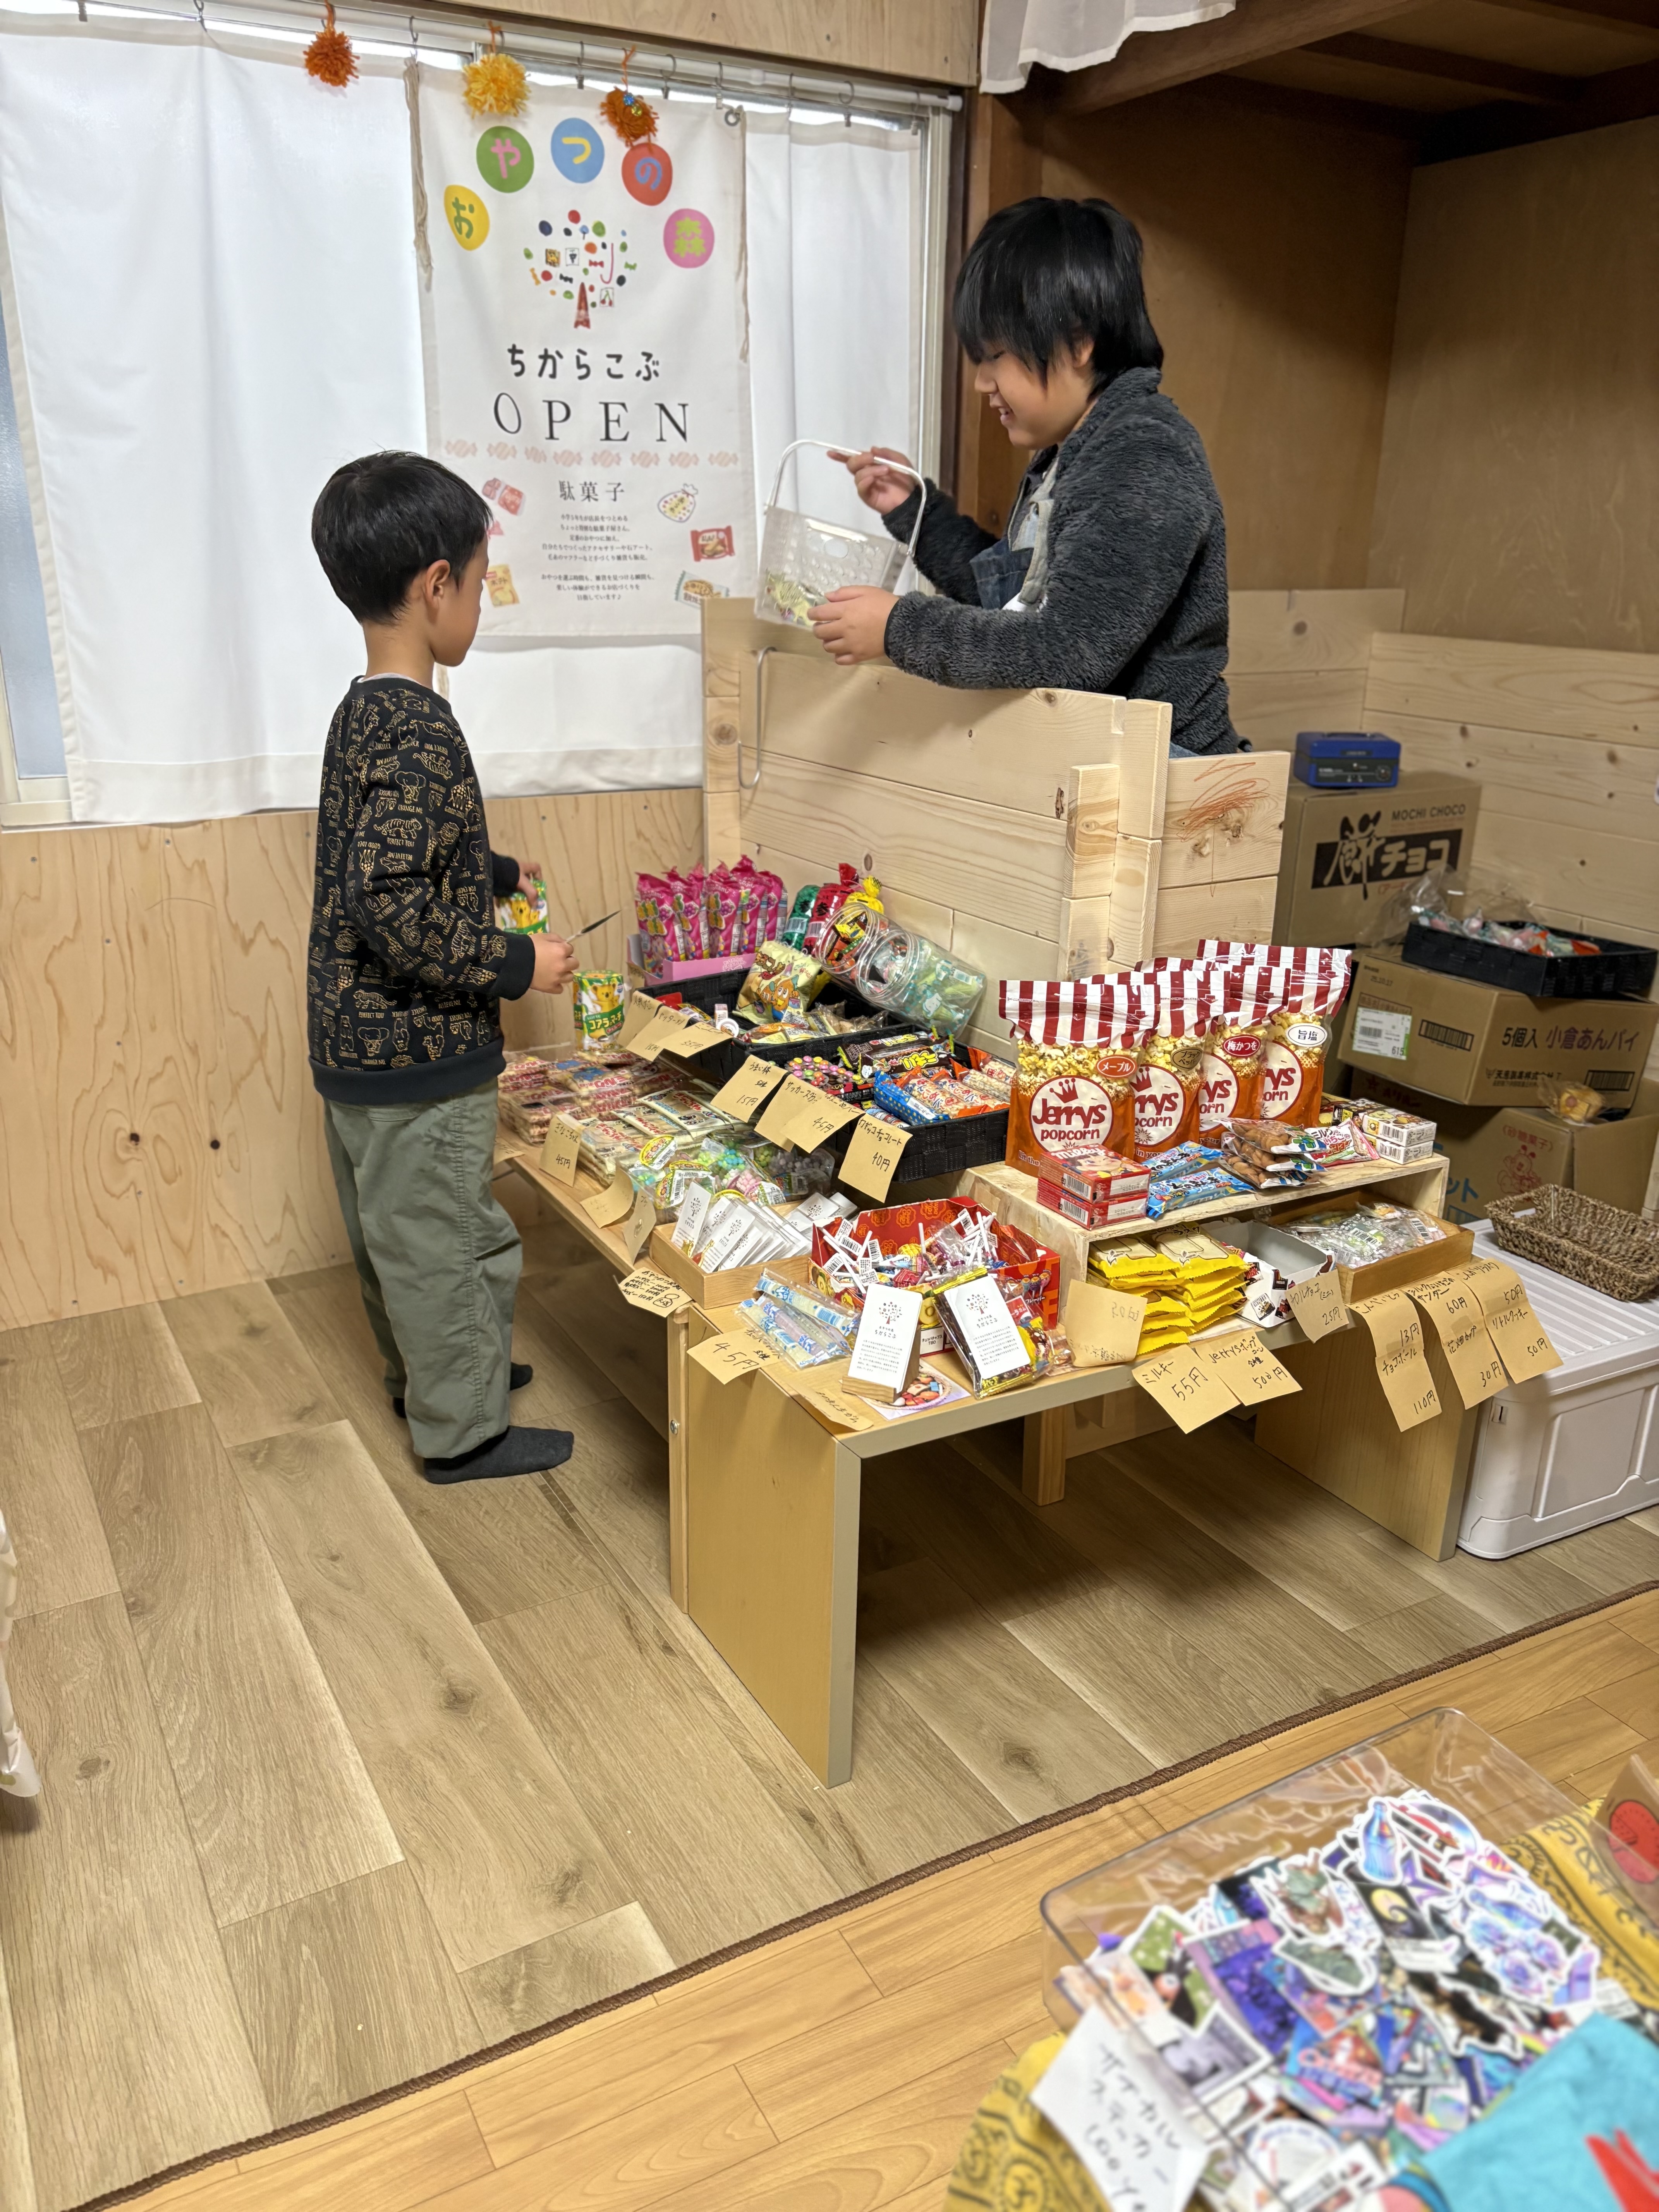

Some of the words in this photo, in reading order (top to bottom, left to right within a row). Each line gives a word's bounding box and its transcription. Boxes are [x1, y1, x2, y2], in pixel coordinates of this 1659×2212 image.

[507, 344, 659, 381] ちからこぶ
[494, 393, 689, 442] OPEN
[558, 479, 625, 503] 駄菓子
[1392, 809, 1426, 820] MOCHI
[1430, 804, 1466, 817] CHOCO
[1298, 1030, 1318, 1041] 旨塩
[1502, 1027, 1537, 1049] 5個入
[1546, 1025, 1639, 1052] 小倉あんパイ
[1227, 1041, 1257, 1051] 梅かつを
[1392, 1046, 1405, 1056] 615
[749, 1062, 771, 1075] うまい棒
[1101, 1061, 1132, 1072] メープル
[736, 1094, 759, 1106] 15円
[1032, 1098, 1107, 1129] Jerrys
[813, 1117, 834, 1133] 45円
[1041, 1128, 1100, 1142] popcorn
[556, 1154, 571, 1169] 45円
[1027, 1156, 1040, 1166] the
[1136, 1147, 1144, 1157] in
[872, 1152, 891, 1172] 40円
[1025, 1296, 1046, 1305] フレーバー
[1254, 1294, 1267, 1307] WHITE
[1504, 1284, 1524, 1304] 50円
[1448, 1297, 1468, 1314] 60円
[1322, 1307, 1343, 1326] 25円
[875, 1330, 896, 1339] ちからこぶ
[1400, 1322, 1420, 1346] 13円
[713, 1342, 759, 1369] 45円
[1527, 1338, 1548, 1357] 50円
[1382, 1348, 1417, 1376] チョコボール
[1142, 1361, 1175, 1384] ミルキー
[1252, 1367, 1288, 1389] 500円
[1482, 1361, 1501, 1387] 30円
[1174, 1367, 1208, 1401] 55円
[1414, 1390, 1436, 1414] 110円
